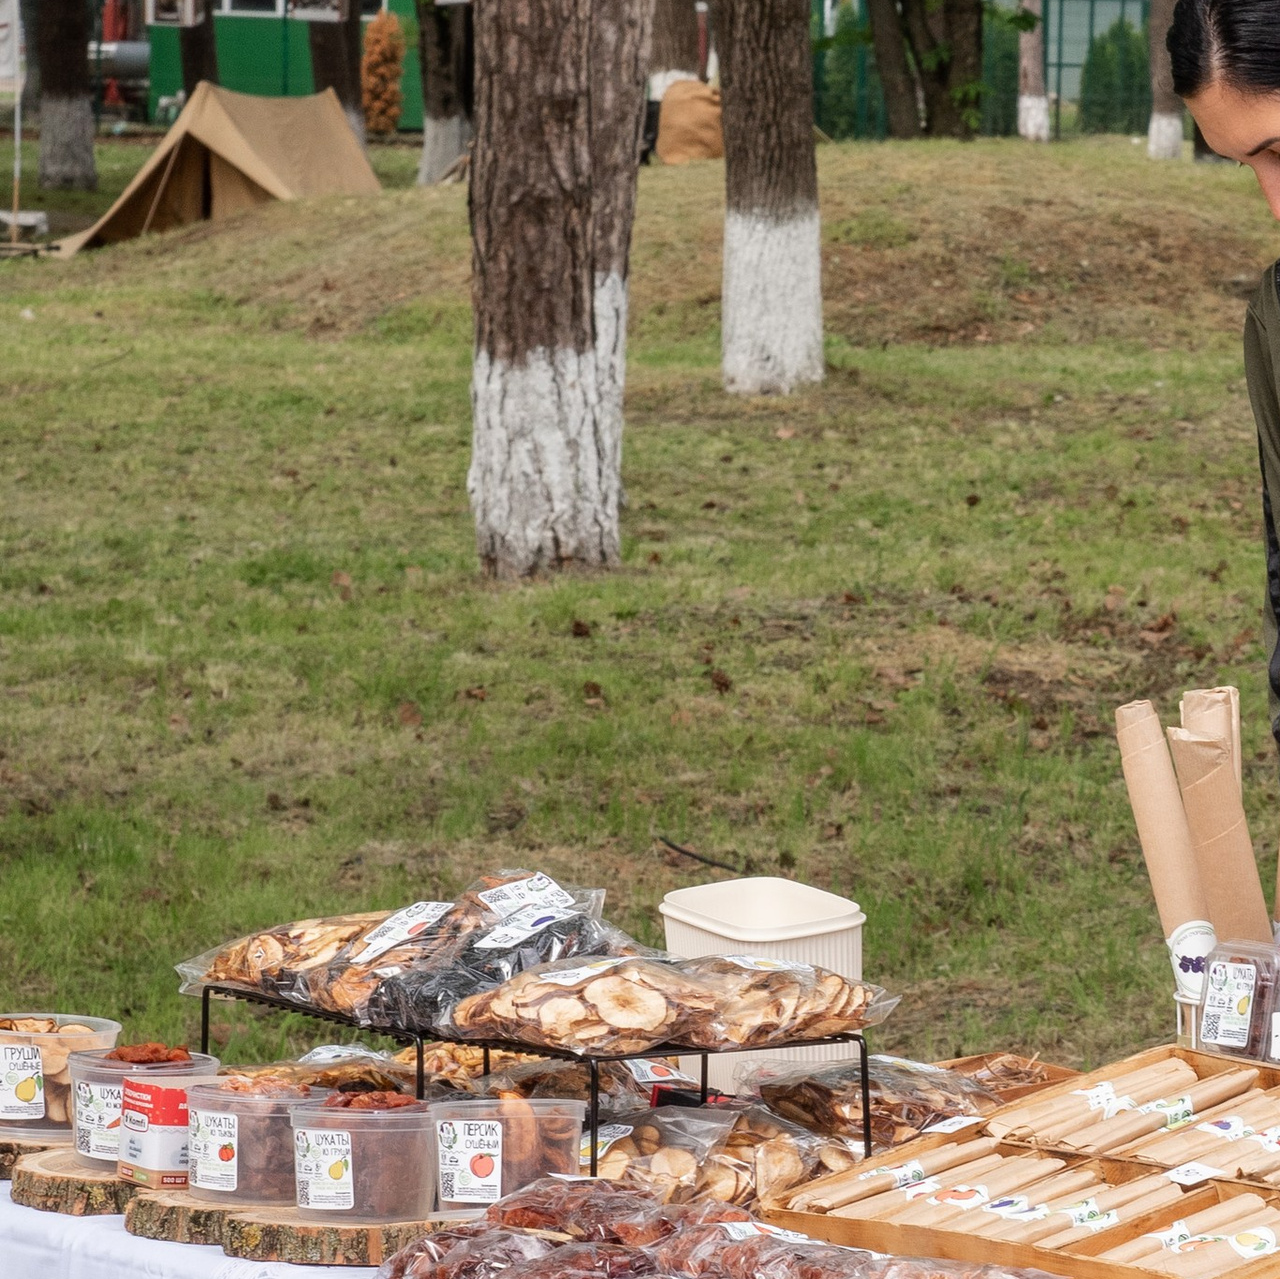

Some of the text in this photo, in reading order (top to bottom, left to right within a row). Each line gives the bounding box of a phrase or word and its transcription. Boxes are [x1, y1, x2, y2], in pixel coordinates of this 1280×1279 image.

[4, 1047, 40, 1060] ГРУШИ
[100, 1087, 122, 1100] ЦУКА
[205, 1116, 235, 1129] ЦУКАТЫ
[463, 1123, 498, 1136] ПЕРСИК
[315, 1134, 349, 1146] ЦУКАТЫ
